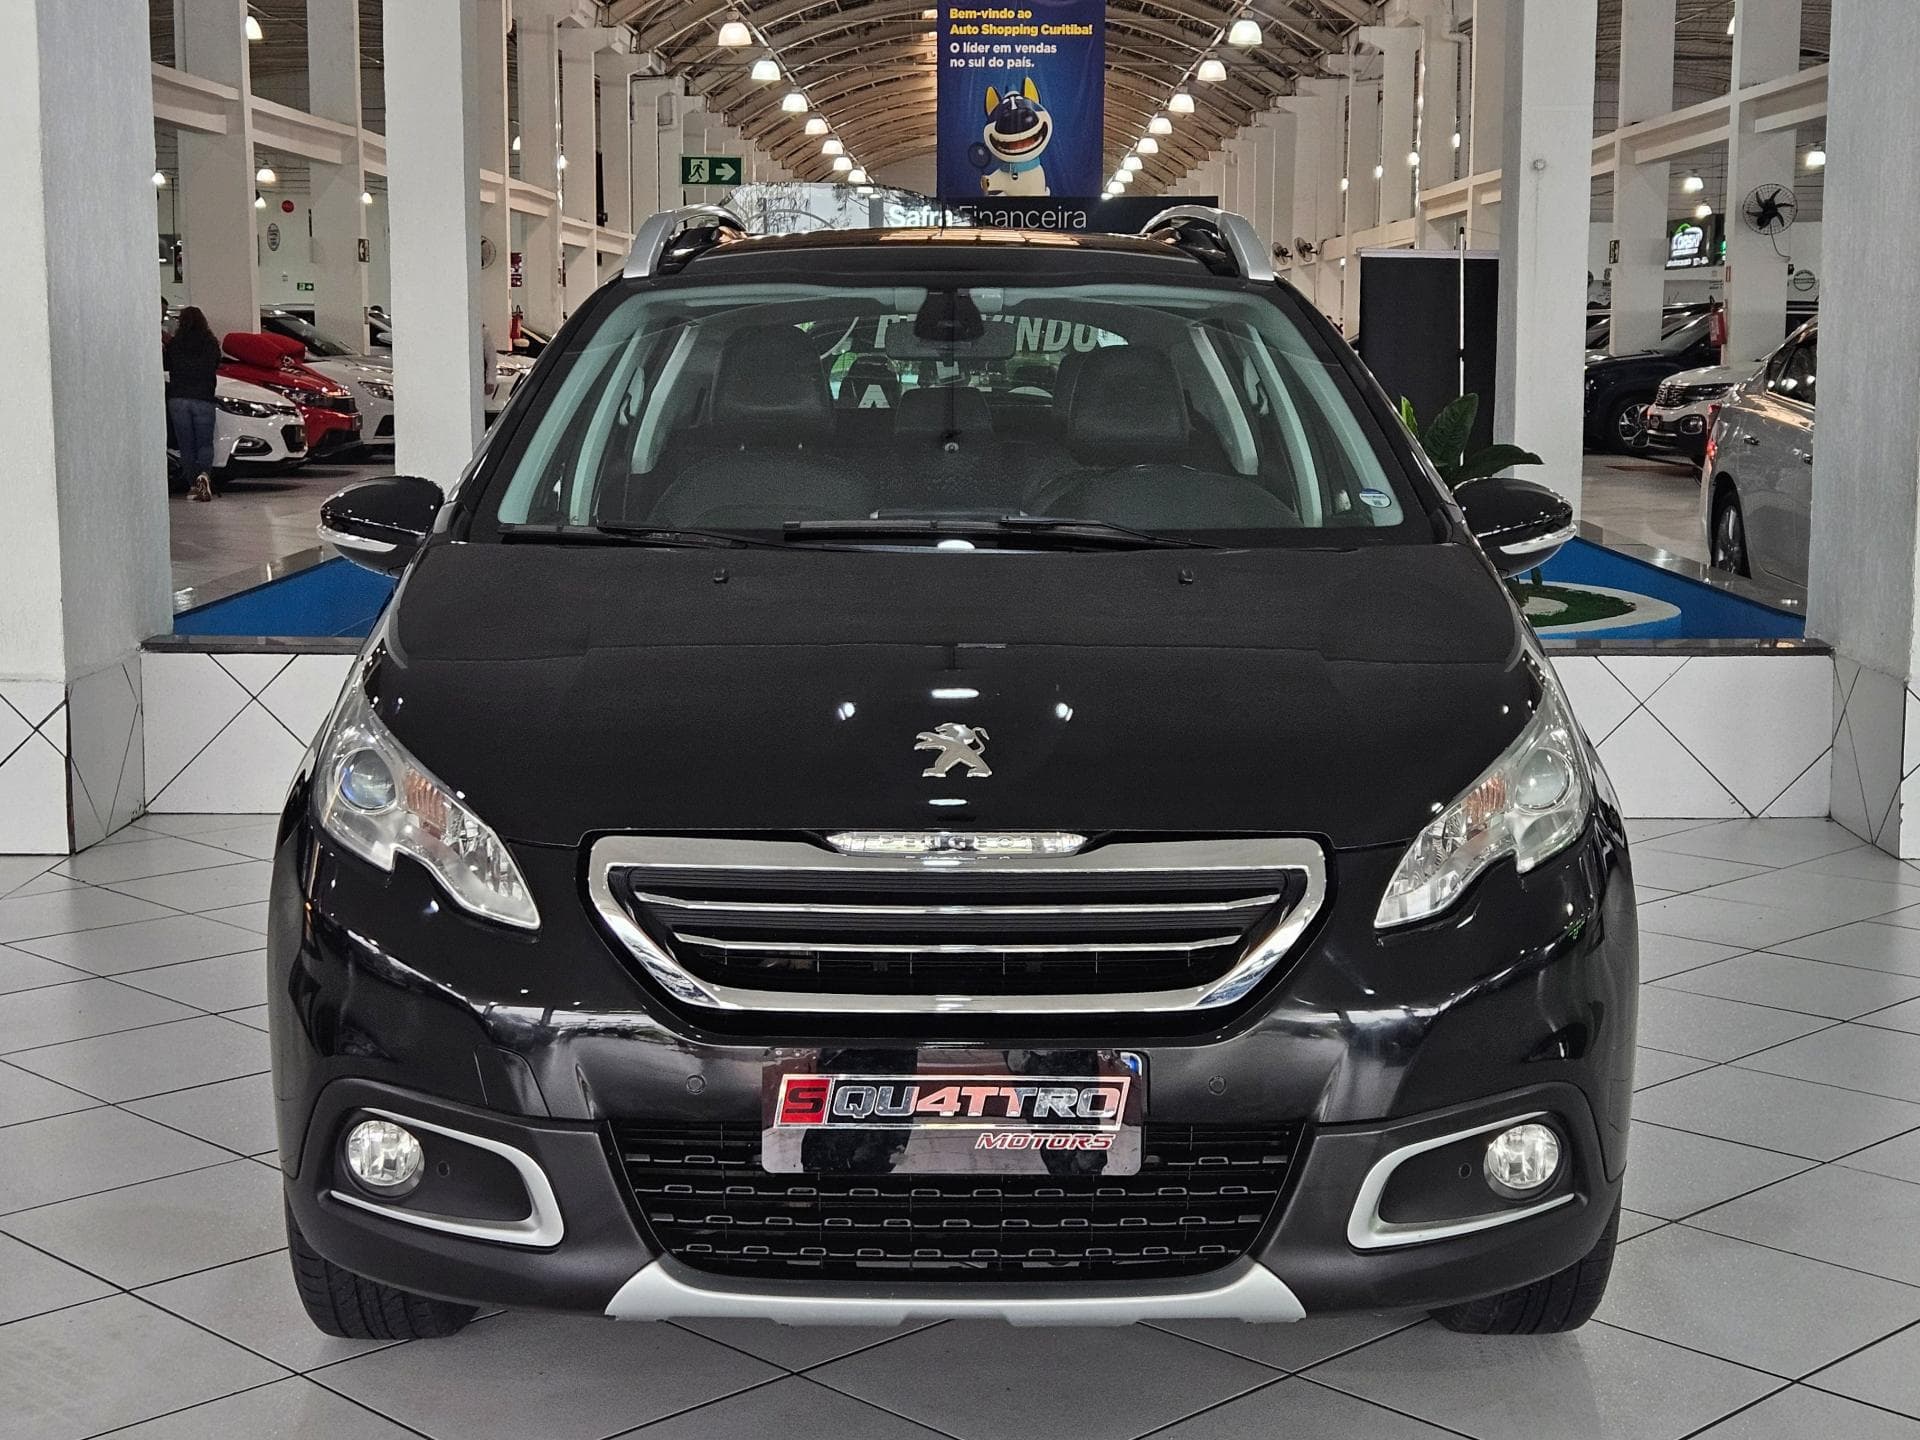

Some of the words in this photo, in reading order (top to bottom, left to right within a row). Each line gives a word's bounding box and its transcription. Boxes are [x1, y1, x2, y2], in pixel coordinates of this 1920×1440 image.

[949, 8, 1015, 19] Bem-vindo
[1017, 10, 1032, 19] ao
[949, 24, 979, 35] Auto
[981, 24, 1038, 37] Shopping
[1040, 24, 1093, 35] Curitiba!
[949, 42, 960, 53] O
[963, 42, 990, 53] líder
[993, 44, 1011, 53] em
[1015, 42, 1057, 53] vendas
[949, 58, 965, 67] no
[968, 57, 985, 67] sul
[988, 57, 1004, 67] do
[1007, 56, 1035, 69] país.
[889, 204, 953, 228] Safra
[975, 1132, 1117, 1150] MOTORS
